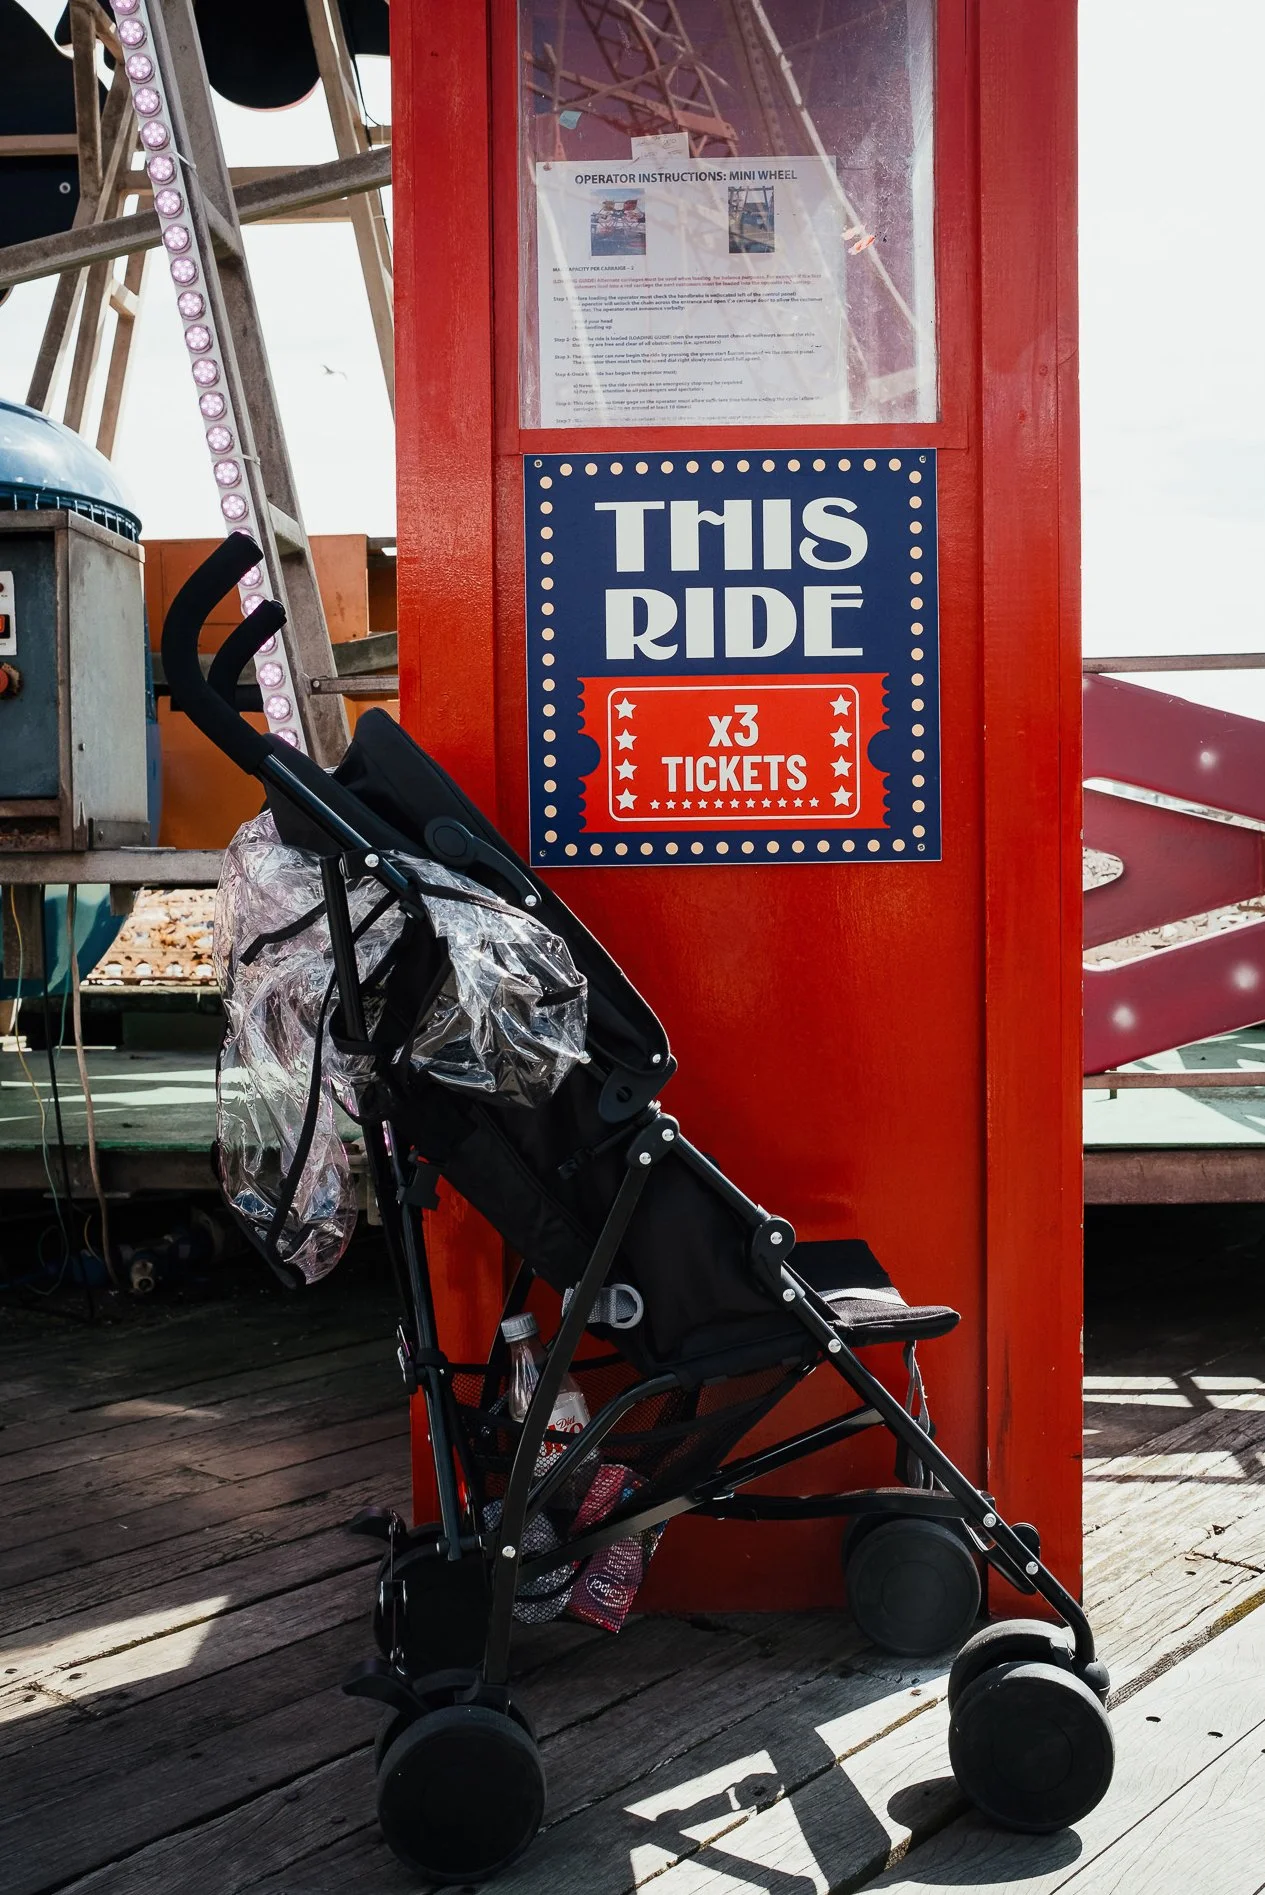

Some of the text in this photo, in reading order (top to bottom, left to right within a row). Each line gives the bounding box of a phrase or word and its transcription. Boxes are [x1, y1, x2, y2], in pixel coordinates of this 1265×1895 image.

[575, 170, 797, 184] OPERATOR INSTRUCTIONS: MINI WHEEL
[594, 497, 868, 572] THIS
[605, 585, 864, 660] RIDE
[708, 704, 759, 748] x3
[661, 754, 807, 793] TICKETS
[556, 1416, 575, 1429] Diet
